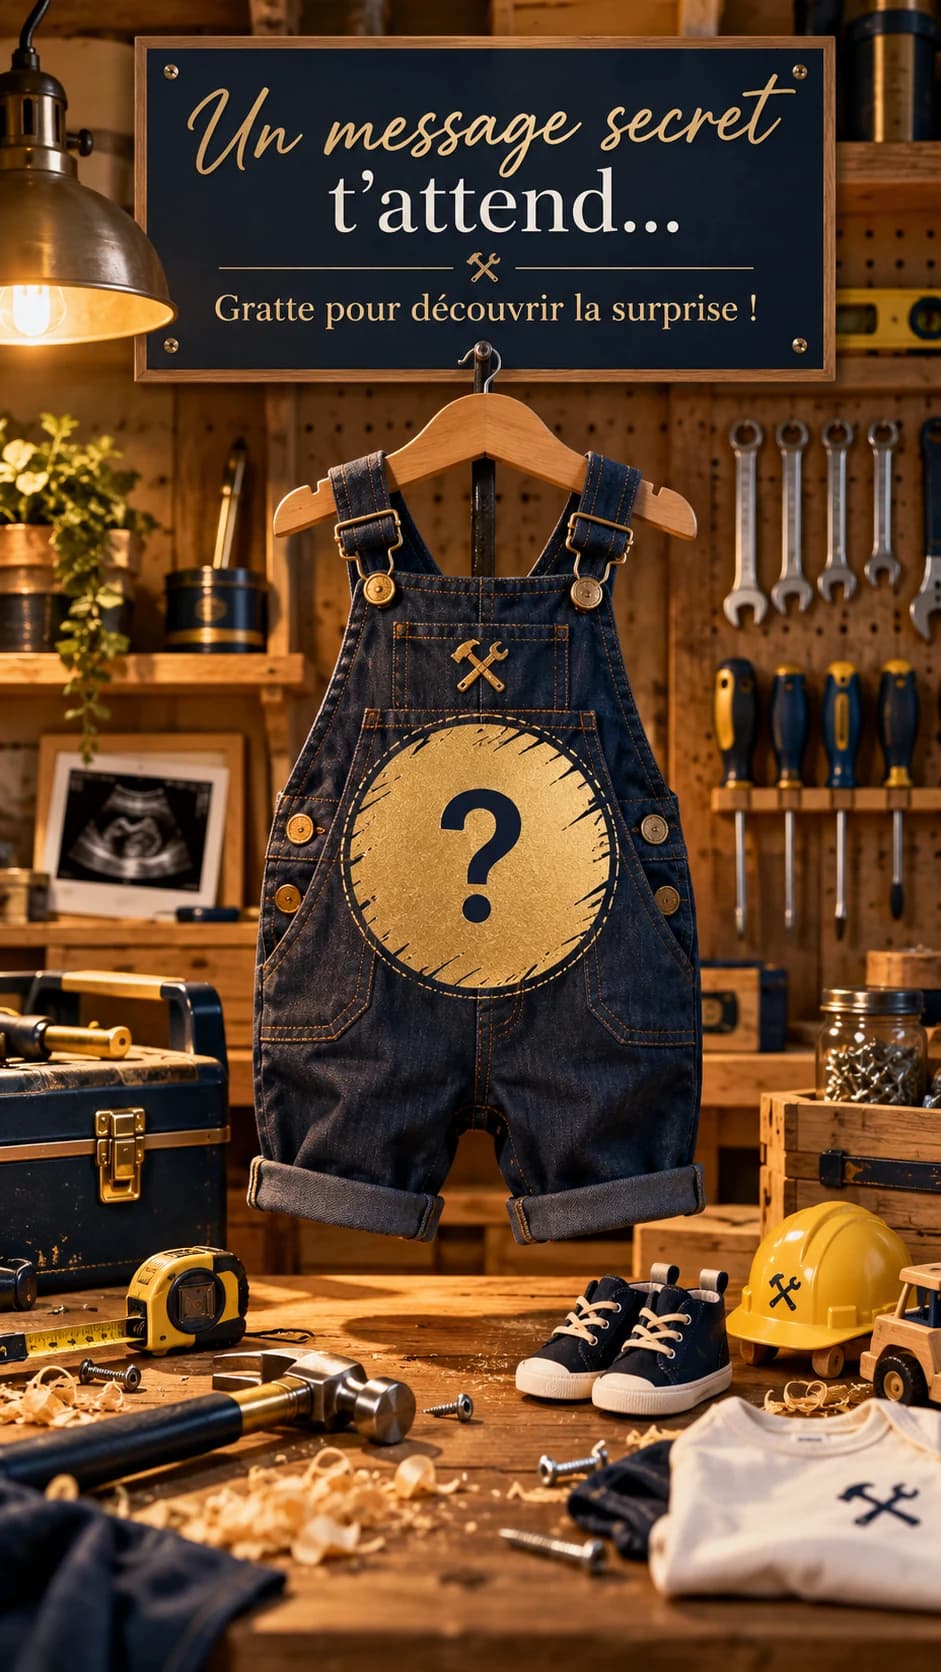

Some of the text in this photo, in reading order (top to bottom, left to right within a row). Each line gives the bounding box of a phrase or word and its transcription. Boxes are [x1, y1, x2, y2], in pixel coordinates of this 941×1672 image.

[187, 73, 797, 178] Un message secret
[328, 166, 680, 234] t’attend...
[214, 294, 315, 322] Gratte
[325, 302, 401, 330] pour
[411, 292, 565, 322] découvrir
[574, 292, 602, 322] la
[612, 293, 738, 330] surprise
